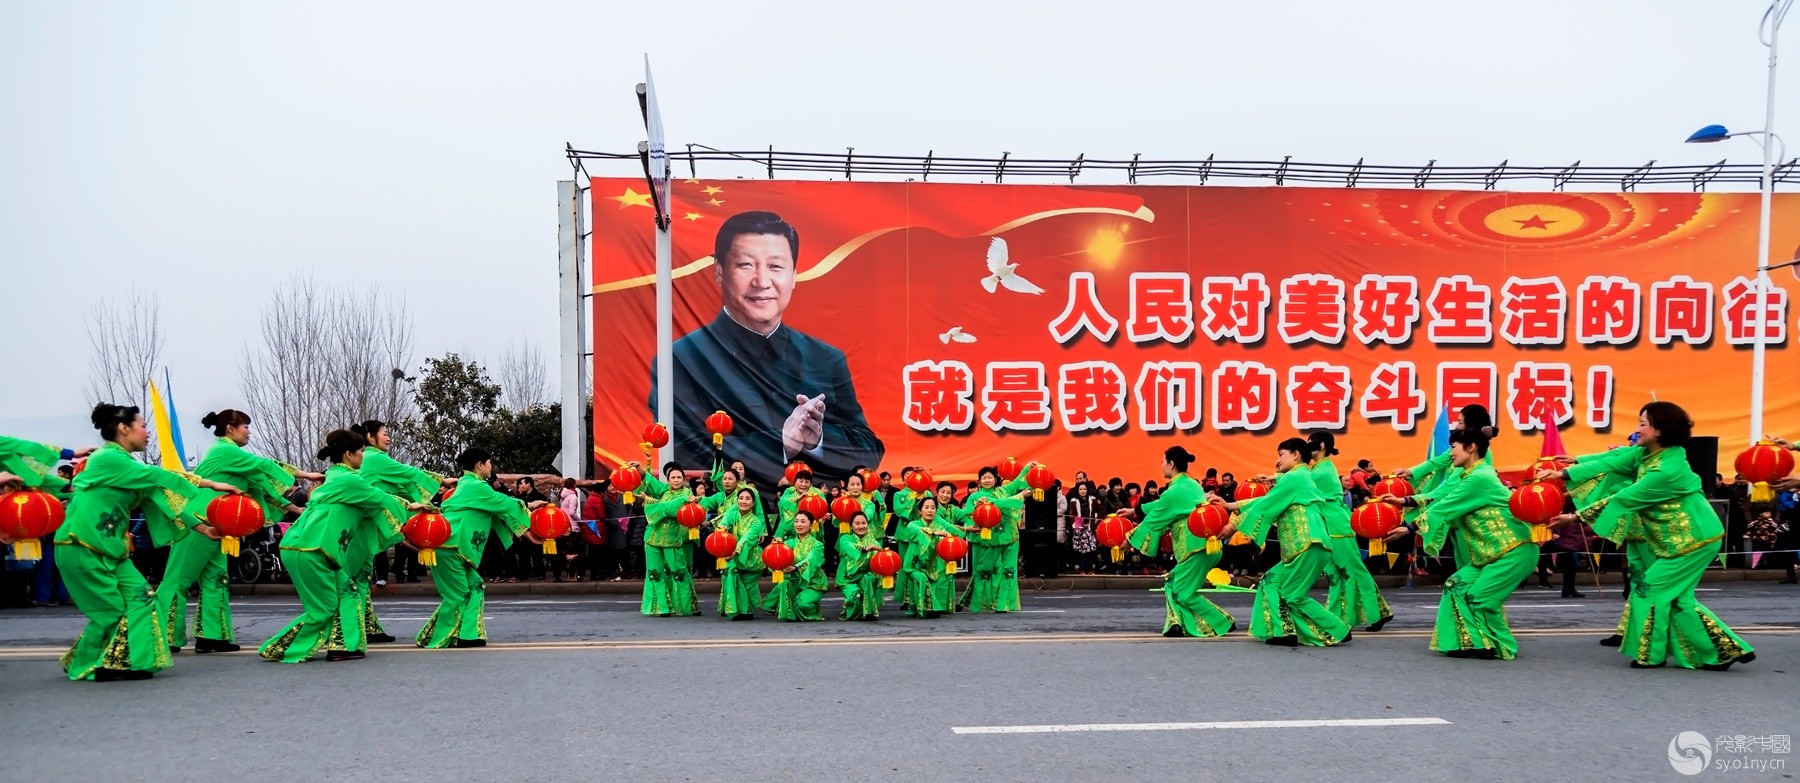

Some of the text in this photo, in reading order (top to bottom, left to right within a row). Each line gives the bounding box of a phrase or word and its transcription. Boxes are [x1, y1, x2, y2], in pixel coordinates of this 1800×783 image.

[1049, 272, 1787, 344] 人民对美好生活的向往
[902, 360, 1613, 431] 就是我们的奋斗目标！
